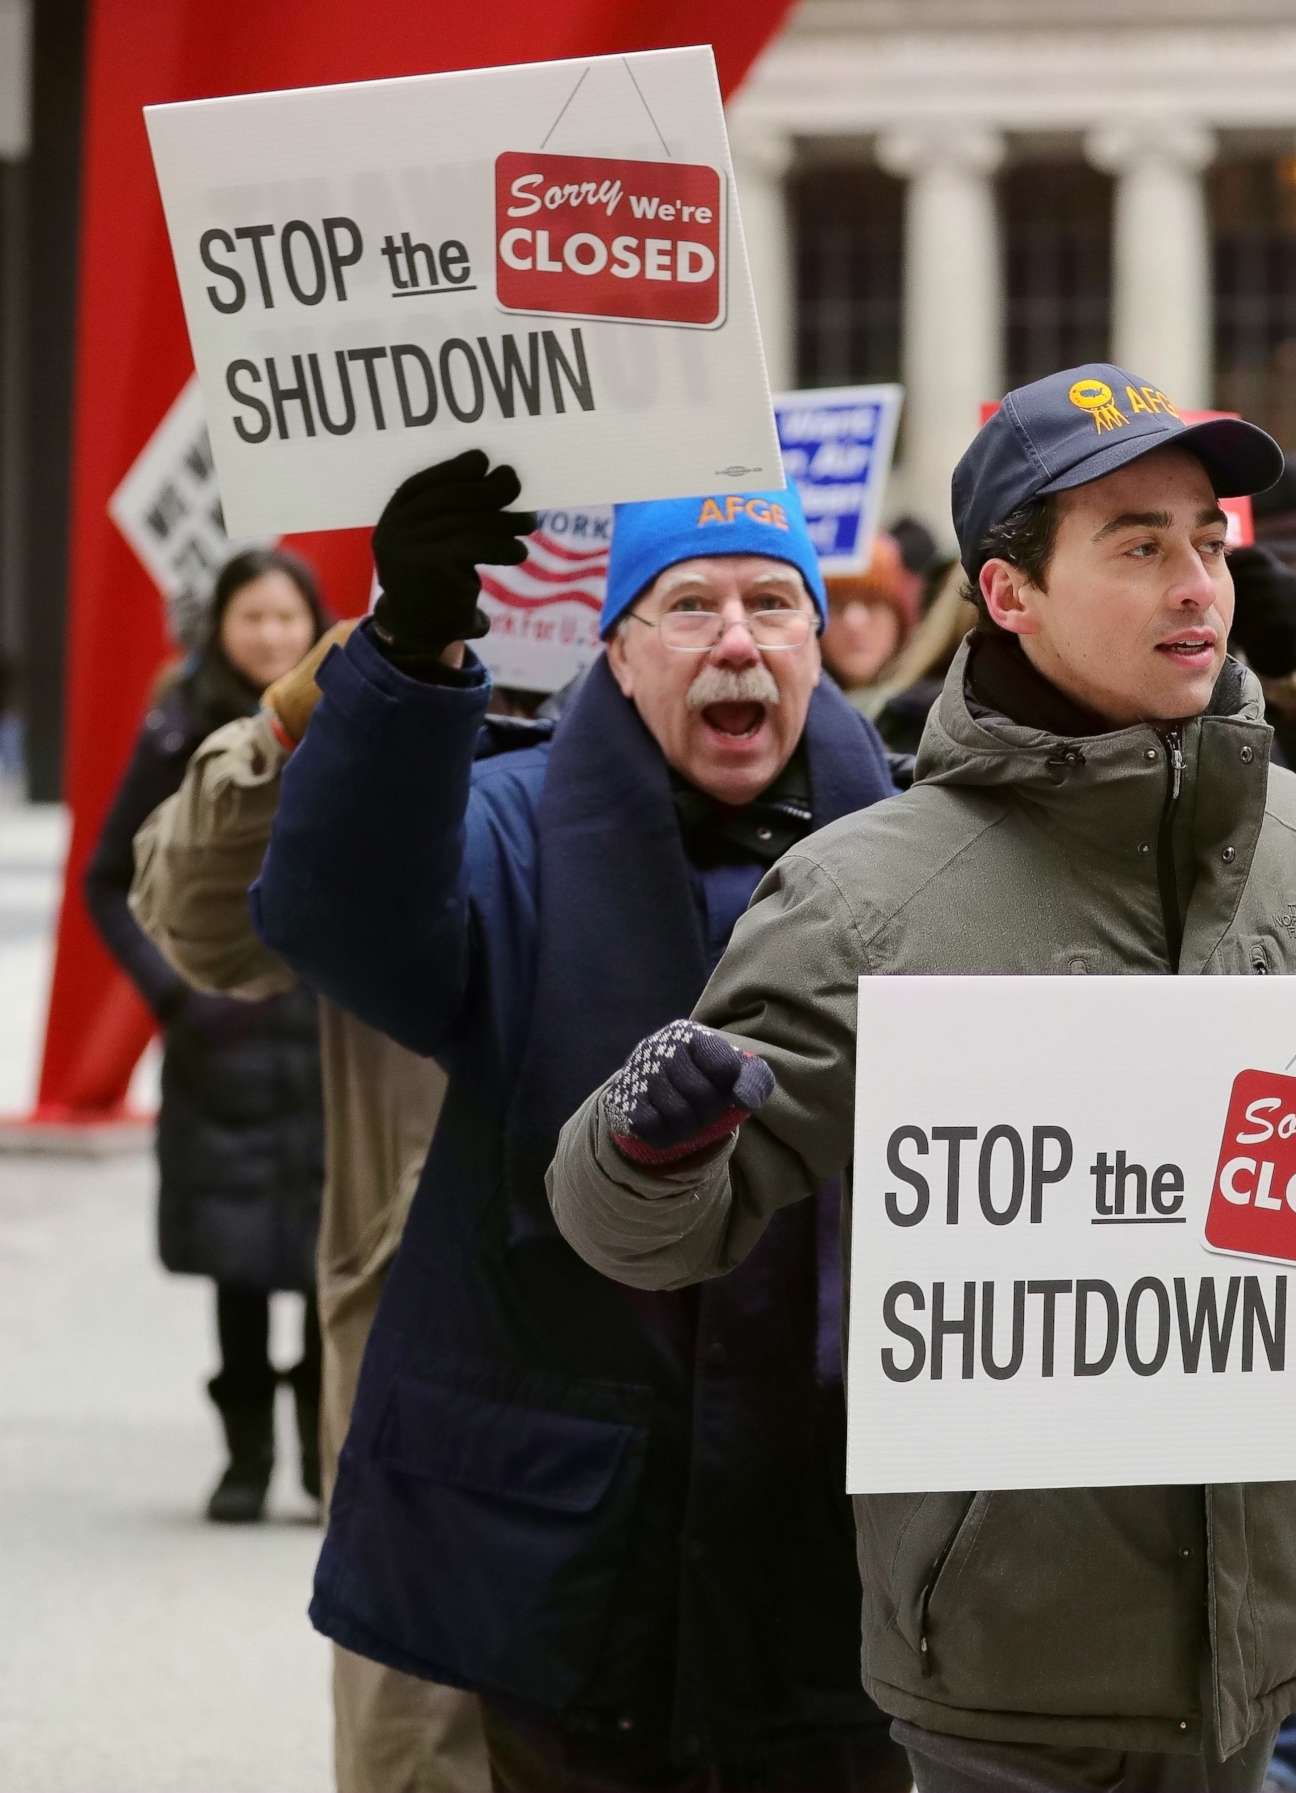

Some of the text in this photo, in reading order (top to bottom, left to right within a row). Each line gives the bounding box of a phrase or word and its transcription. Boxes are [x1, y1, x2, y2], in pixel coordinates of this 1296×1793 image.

[506, 173, 713, 224] Sorry We're
[199, 216, 474, 315] STOP the
[499, 227, 716, 283] CLOSED
[225, 327, 596, 444] SHUTDOWN
[1125, 385, 1180, 418] AFG
[697, 495, 789, 531] AFGE
[884, 1124, 1186, 1228] STOP the
[880, 1275, 1288, 1383] SHUTDOWN
